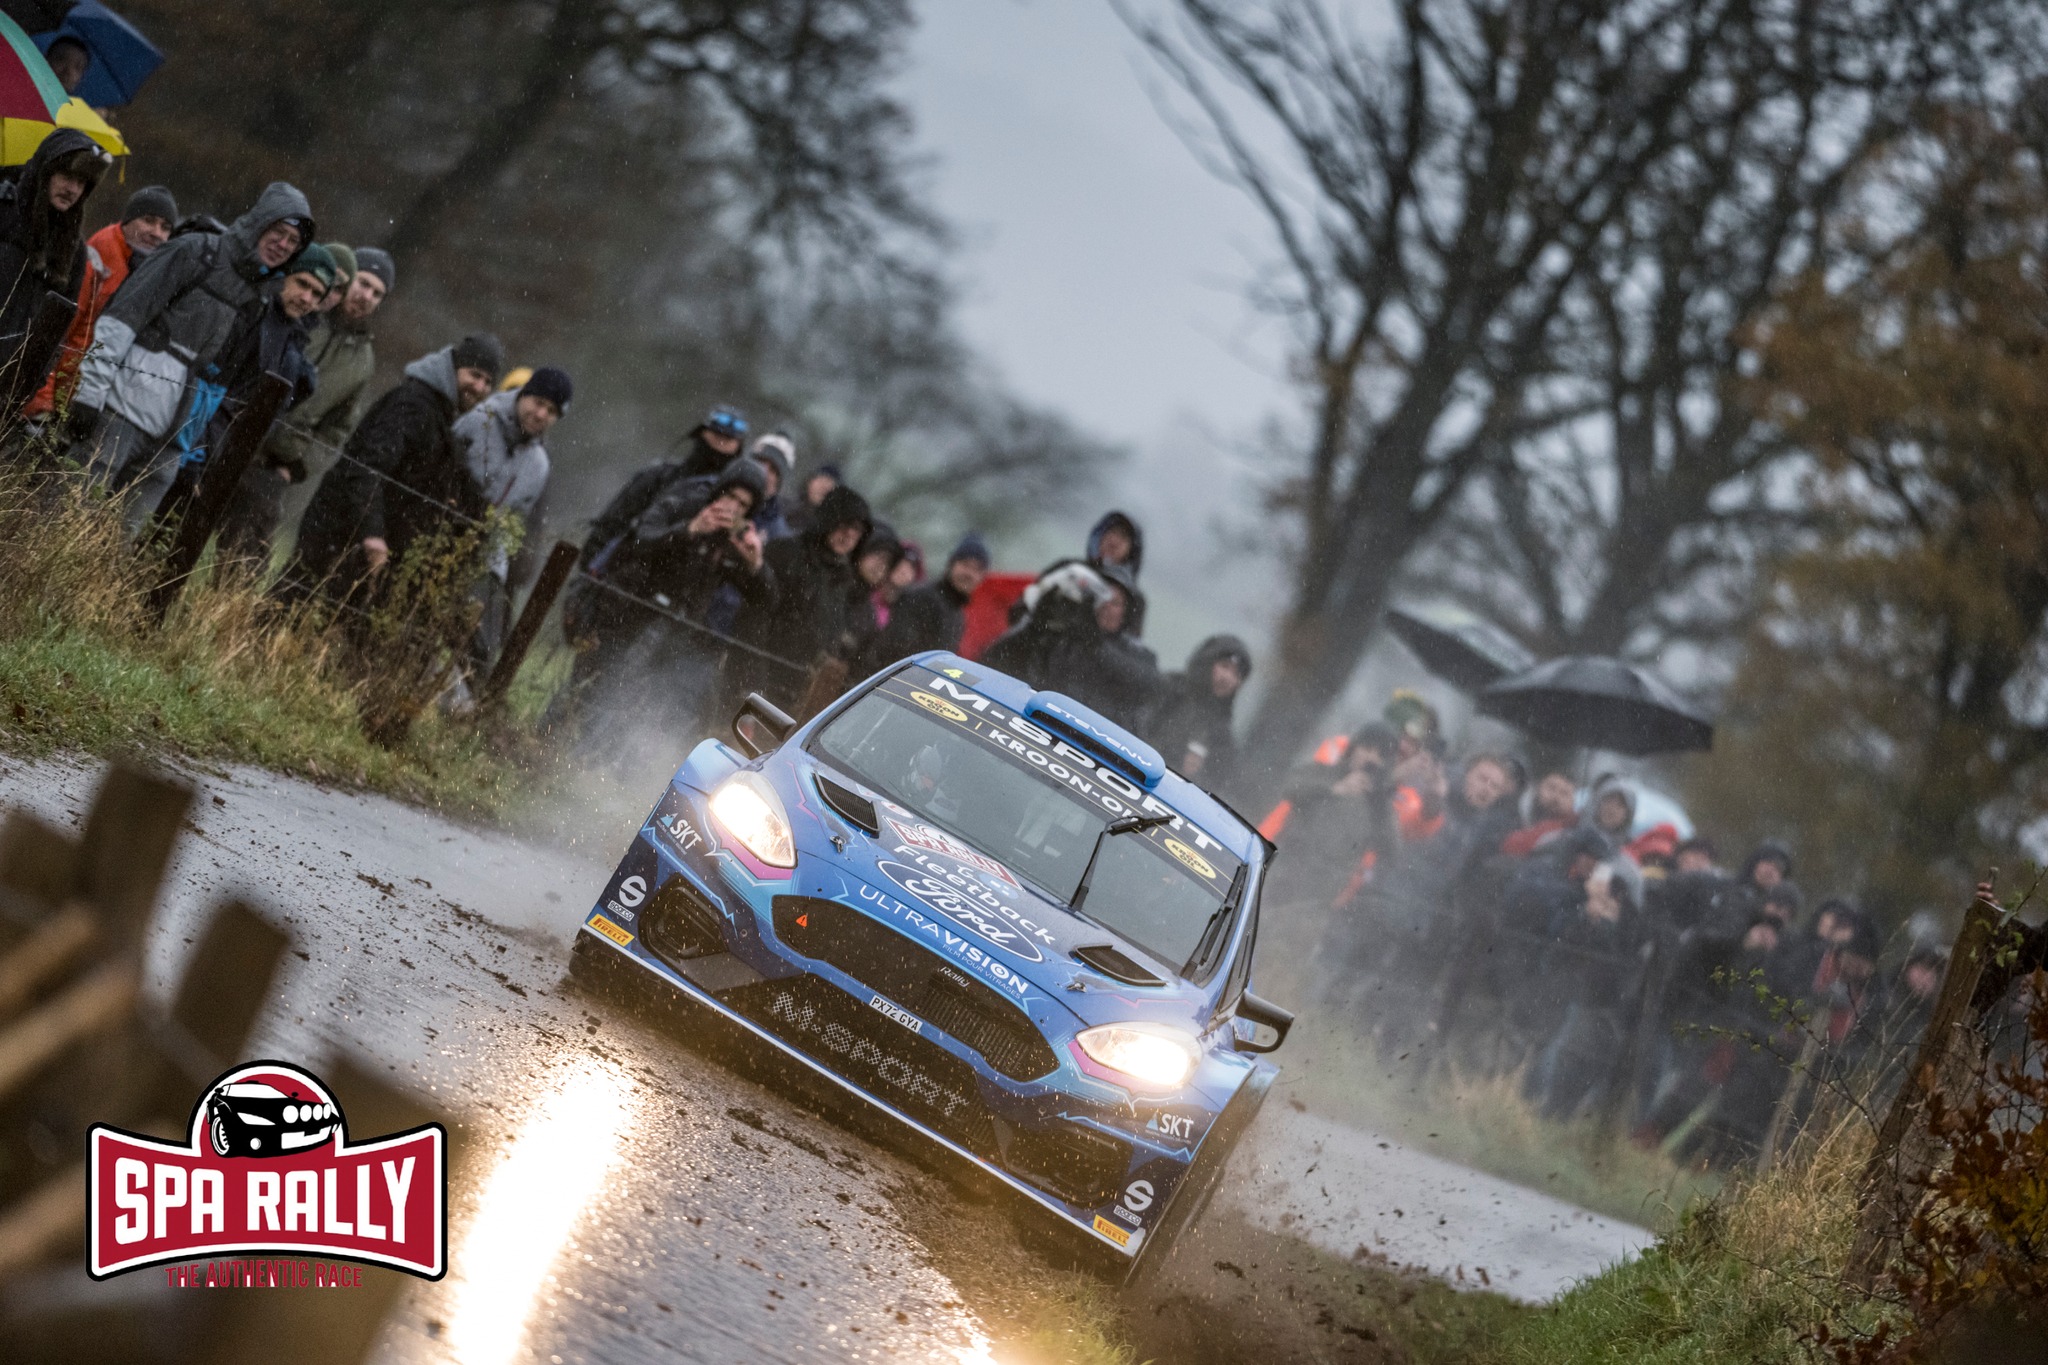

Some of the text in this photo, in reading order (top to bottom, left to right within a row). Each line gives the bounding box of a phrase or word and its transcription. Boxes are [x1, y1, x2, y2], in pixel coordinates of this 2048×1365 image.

[917, 694, 960, 718] KROON
[926, 702, 945, 715] OIL
[929, 677, 1223, 851] M-SPORT
[669, 819, 703, 850] SKT
[1170, 843, 1209, 873] KROON
[1179, 853, 1196, 869] OIL
[905, 878, 1018, 944] Ford
[592, 917, 629, 943] PIRELLI
[859, 884, 1029, 995] ULTRAVISION
[939, 966, 971, 988] Rally
[942, 943, 1022, 999] FILM POUR VITRAGES
[871, 997, 919, 1031] PX72 GYA
[1159, 1113, 1194, 1139] SKT
